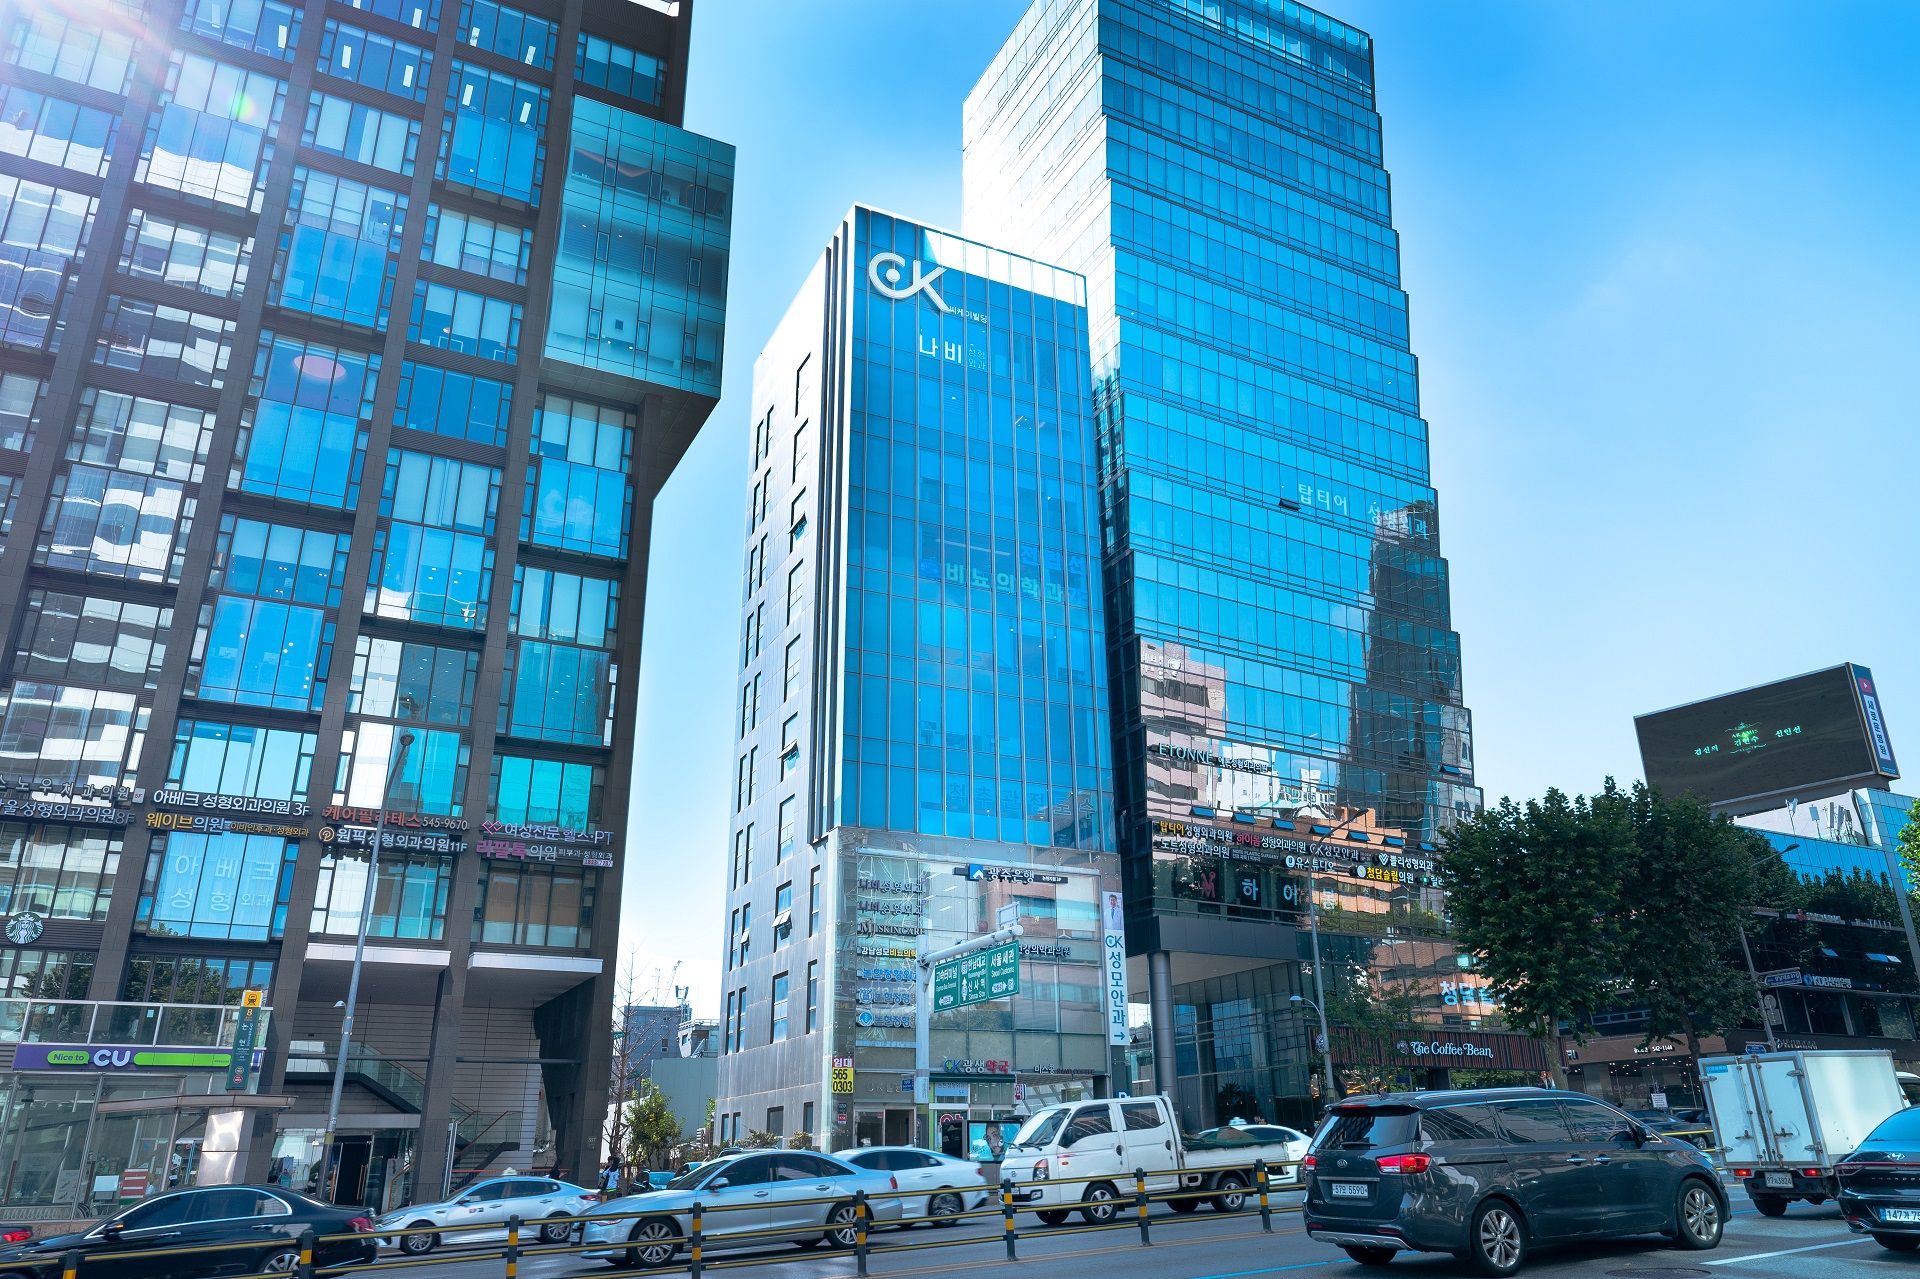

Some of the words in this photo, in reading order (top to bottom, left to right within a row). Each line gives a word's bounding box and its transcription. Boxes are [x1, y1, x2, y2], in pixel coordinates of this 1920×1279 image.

[869, 252, 950, 312] CK
[918, 330, 963, 365] 나비
[1298, 483, 1348, 516] 탑티어
[945, 562, 1064, 603] 비뇨의학과
[1159, 742, 1213, 765] ETONNE
[0, 799, 116, 823] 울성형외과의원
[115, 811, 136, 825] 8F
[153, 789, 200, 807] 아베크
[202, 794, 291, 815] 성형외과의원
[292, 802, 311, 816] 3F
[145, 812, 225, 833] 웨이브의원
[324, 805, 422, 828] 케어필라테스
[422, 816, 469, 831] 545-9670
[504, 822, 561, 841] 여성전문
[450, 841, 468, 852] 11F
[174, 854, 278, 882] 아베크
[987, 867, 1036, 883] 광주은행
[1366, 866, 1415, 884] 청담슬림의원
[169, 886, 273, 913] 성형외과
[1105, 934, 1124, 950] CK
[990, 948, 1015, 967] 서울세관
[1108, 951, 1126, 1028] 성모안과
[246, 1008, 253, 1016] 8
[53, 1053, 72, 1061] Nice
[93, 1049, 131, 1067] CU
[1410, 1041, 1430, 1056] The
[1431, 1041, 1463, 1055] Coffee
[1463, 1043, 1494, 1058] Bean
[833, 1058, 852, 1067] 임대
[832, 1069, 848, 1080] 565
[832, 1081, 853, 1092] 0303
